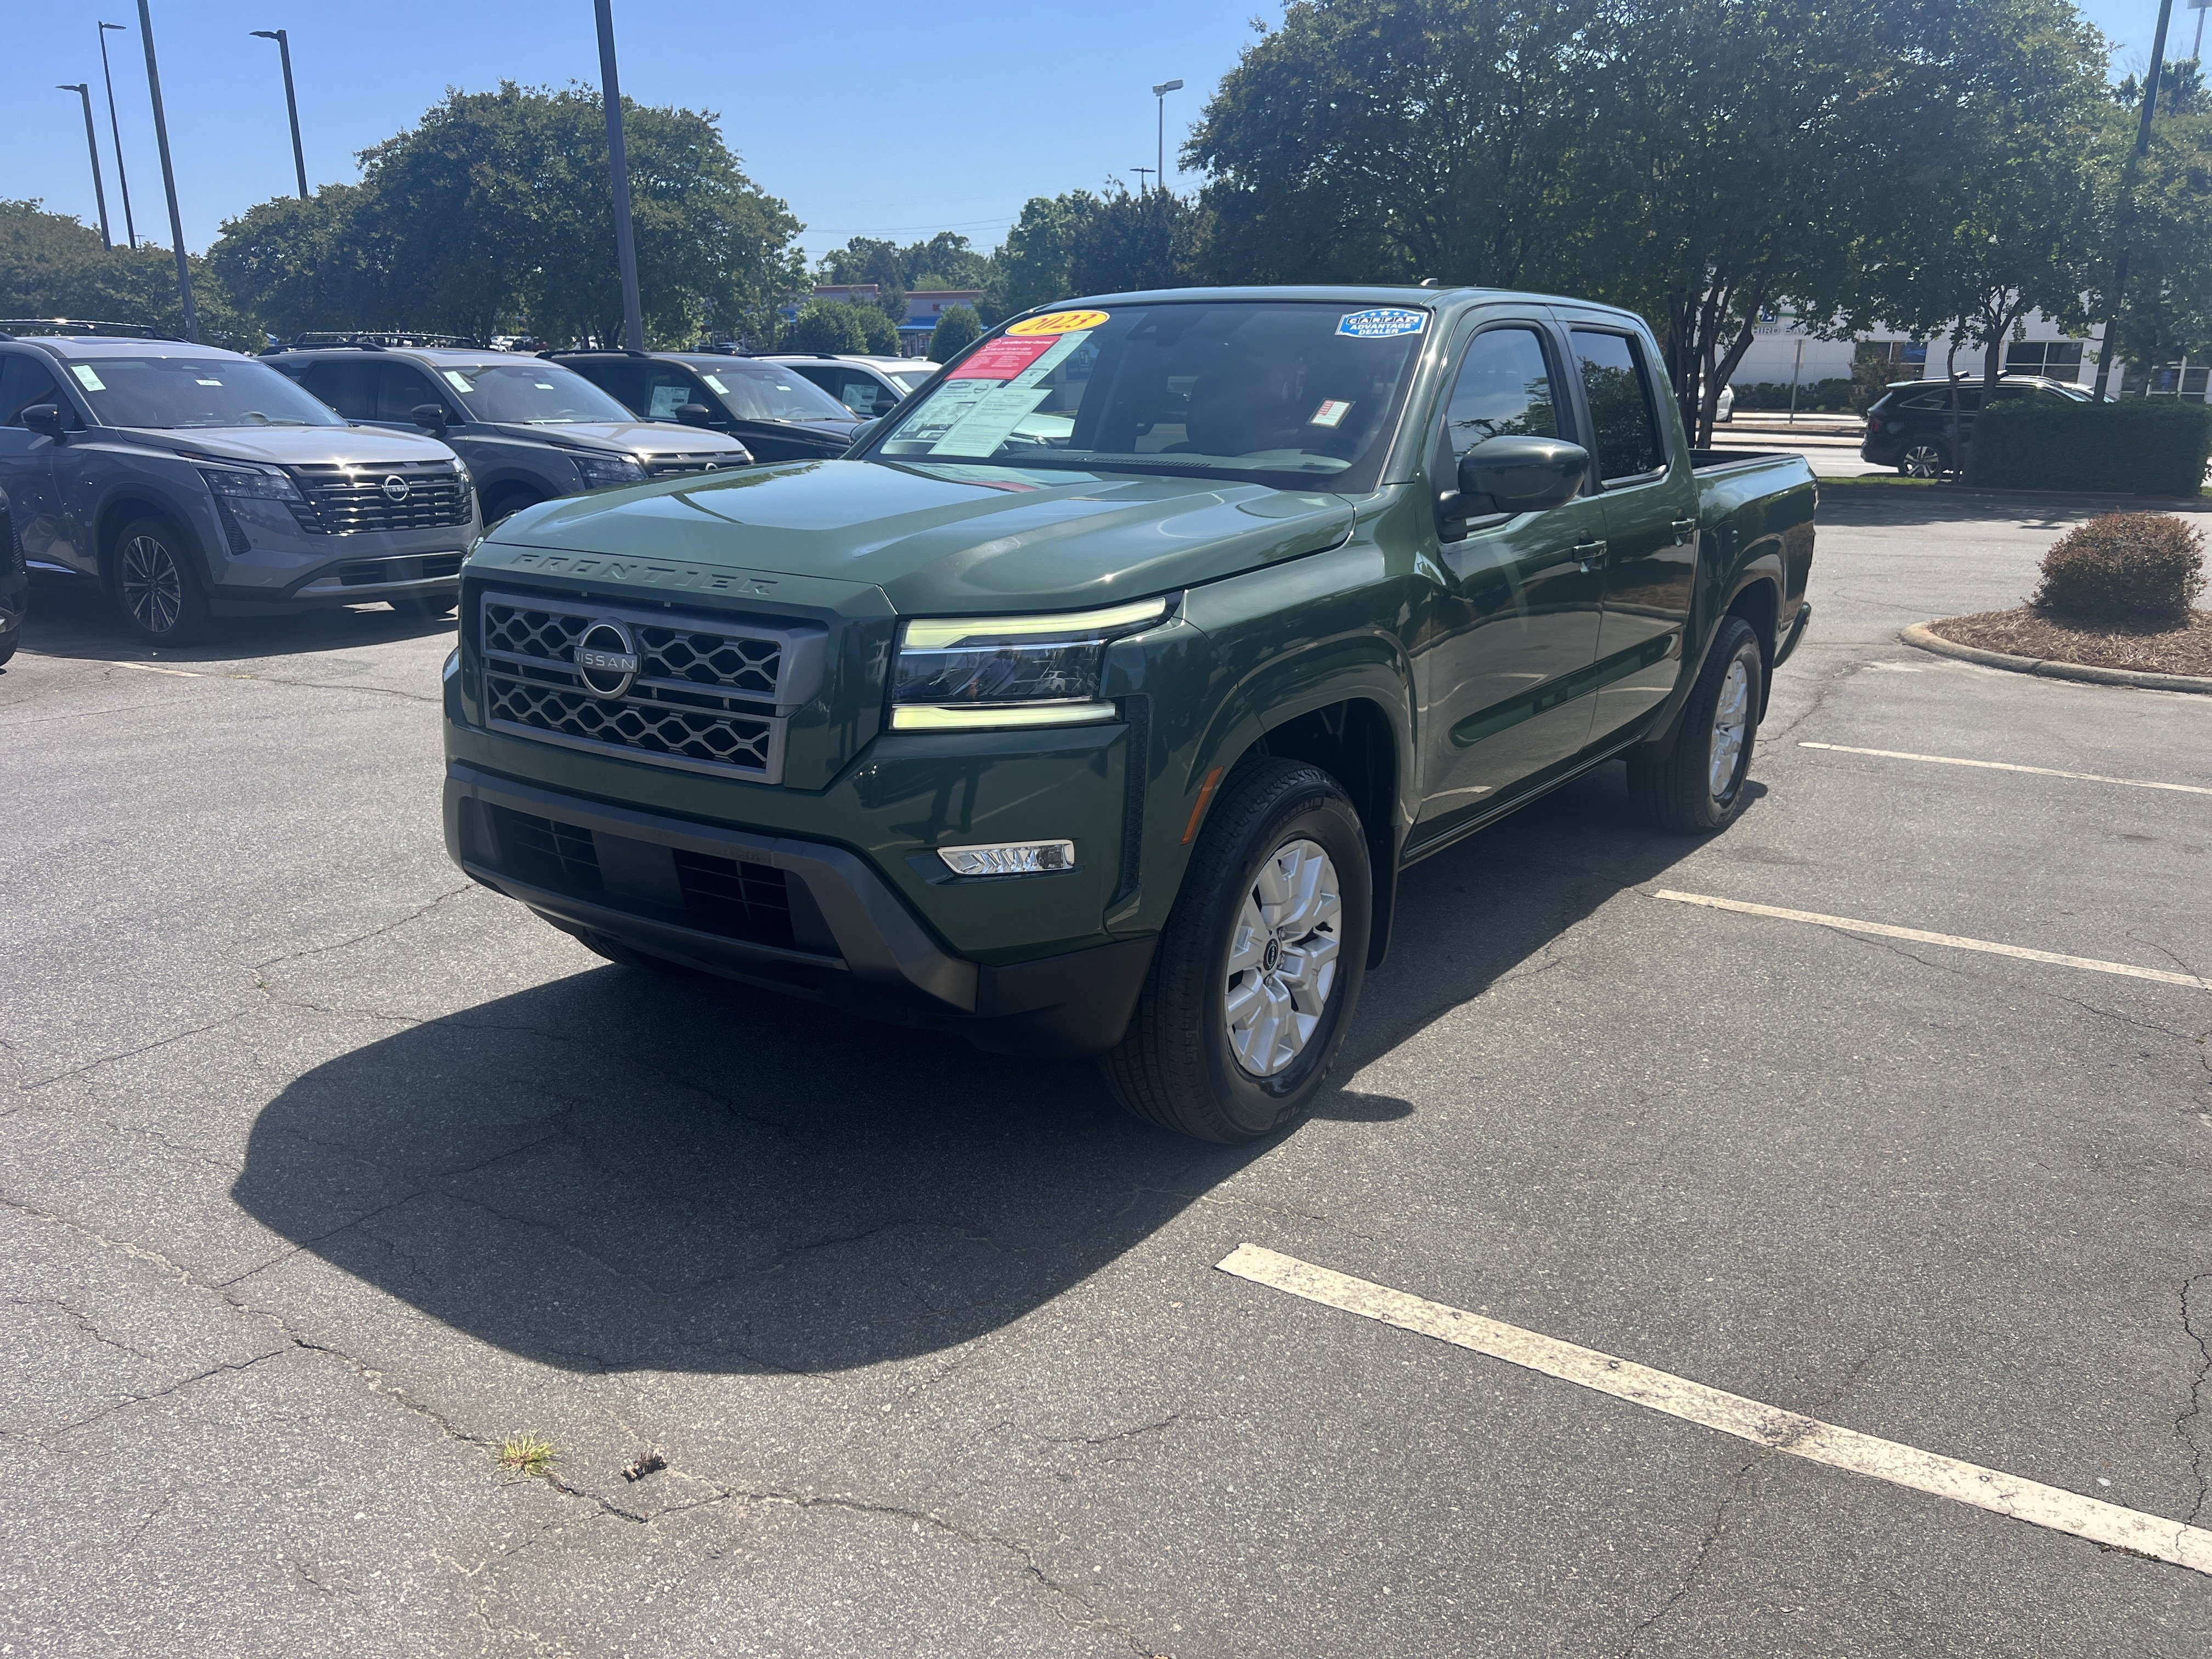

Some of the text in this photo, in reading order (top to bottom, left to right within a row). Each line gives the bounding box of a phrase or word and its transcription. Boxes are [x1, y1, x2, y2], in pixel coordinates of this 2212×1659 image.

[1017, 313, 1097, 332] 2023
[510, 554, 779, 595] FRONTIER
[574, 650, 634, 669] NISSAN
